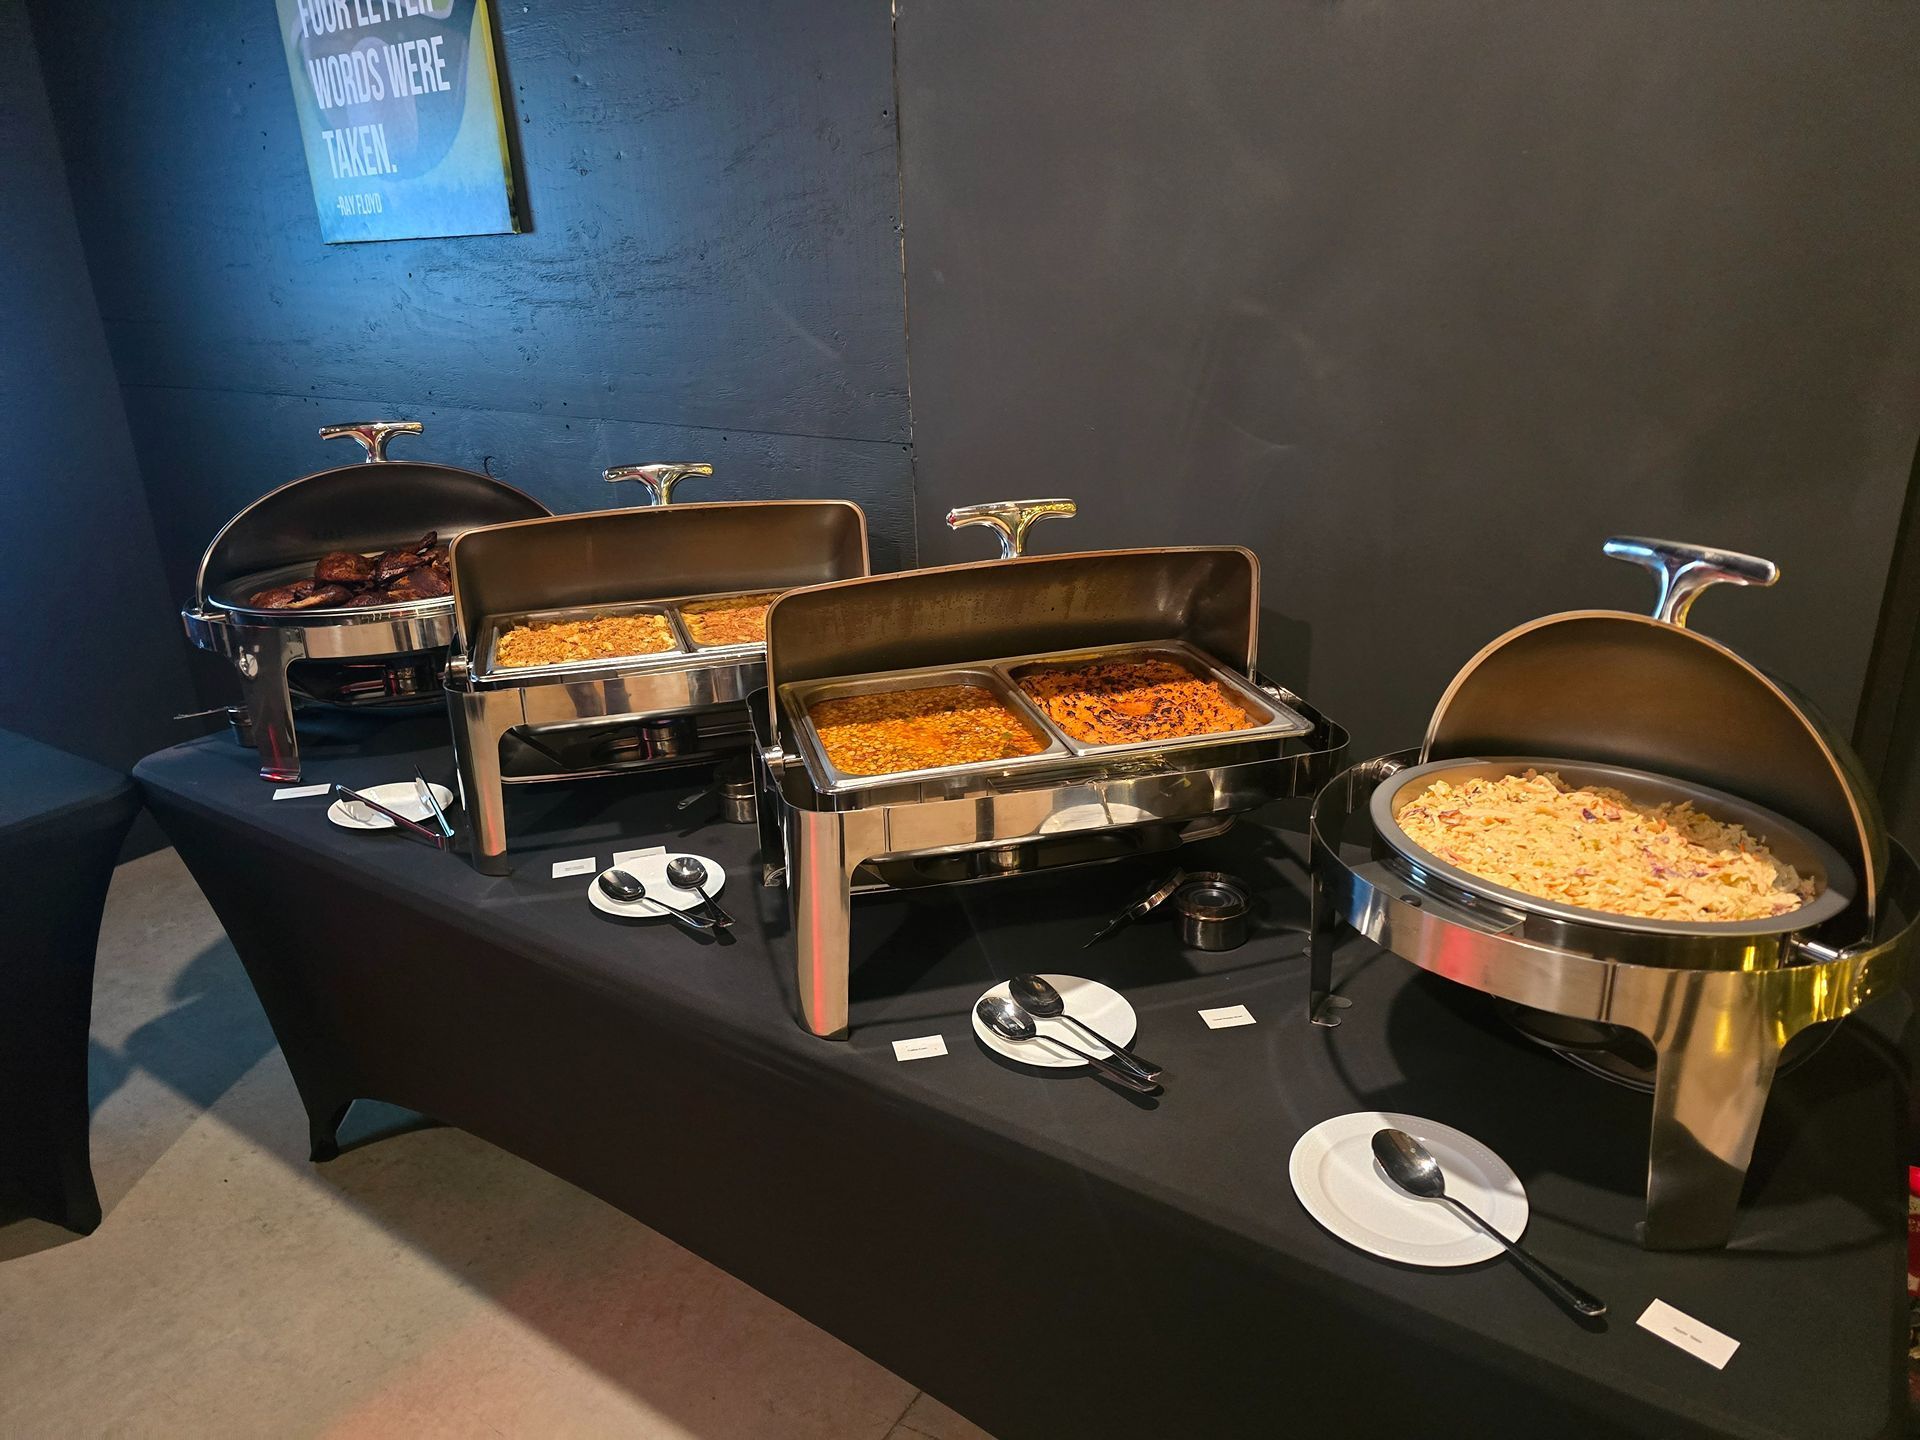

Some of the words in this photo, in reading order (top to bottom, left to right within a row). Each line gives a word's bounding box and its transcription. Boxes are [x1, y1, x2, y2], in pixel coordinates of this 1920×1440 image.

[309, 48, 385, 109] WORDS
[383, 35, 451, 98] WERE
[322, 124, 398, 179] TAKEN.
[337, 194, 356, 216] -RAY
[356, 193, 383, 215] FLOYD
